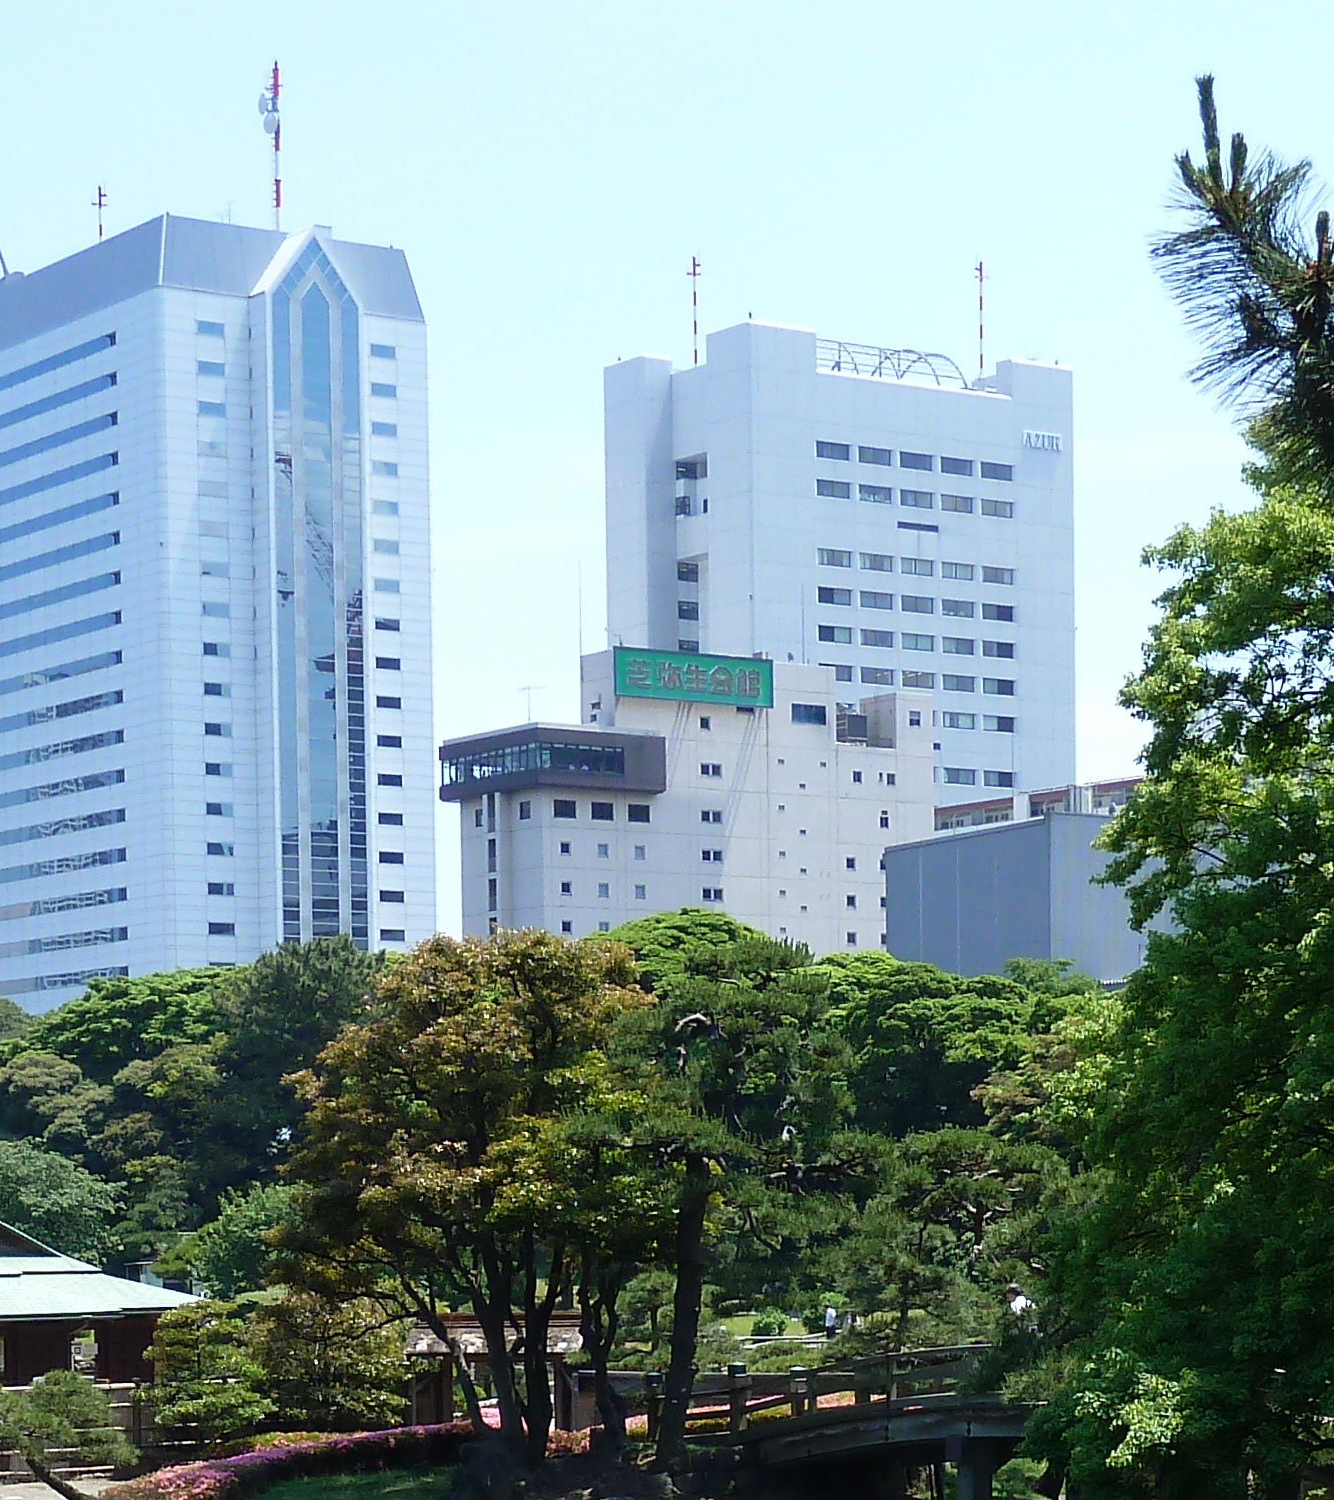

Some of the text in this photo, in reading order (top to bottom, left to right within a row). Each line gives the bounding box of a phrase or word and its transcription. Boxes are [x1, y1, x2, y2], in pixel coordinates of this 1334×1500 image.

[626, 658, 762, 698] 芝弥生会館
